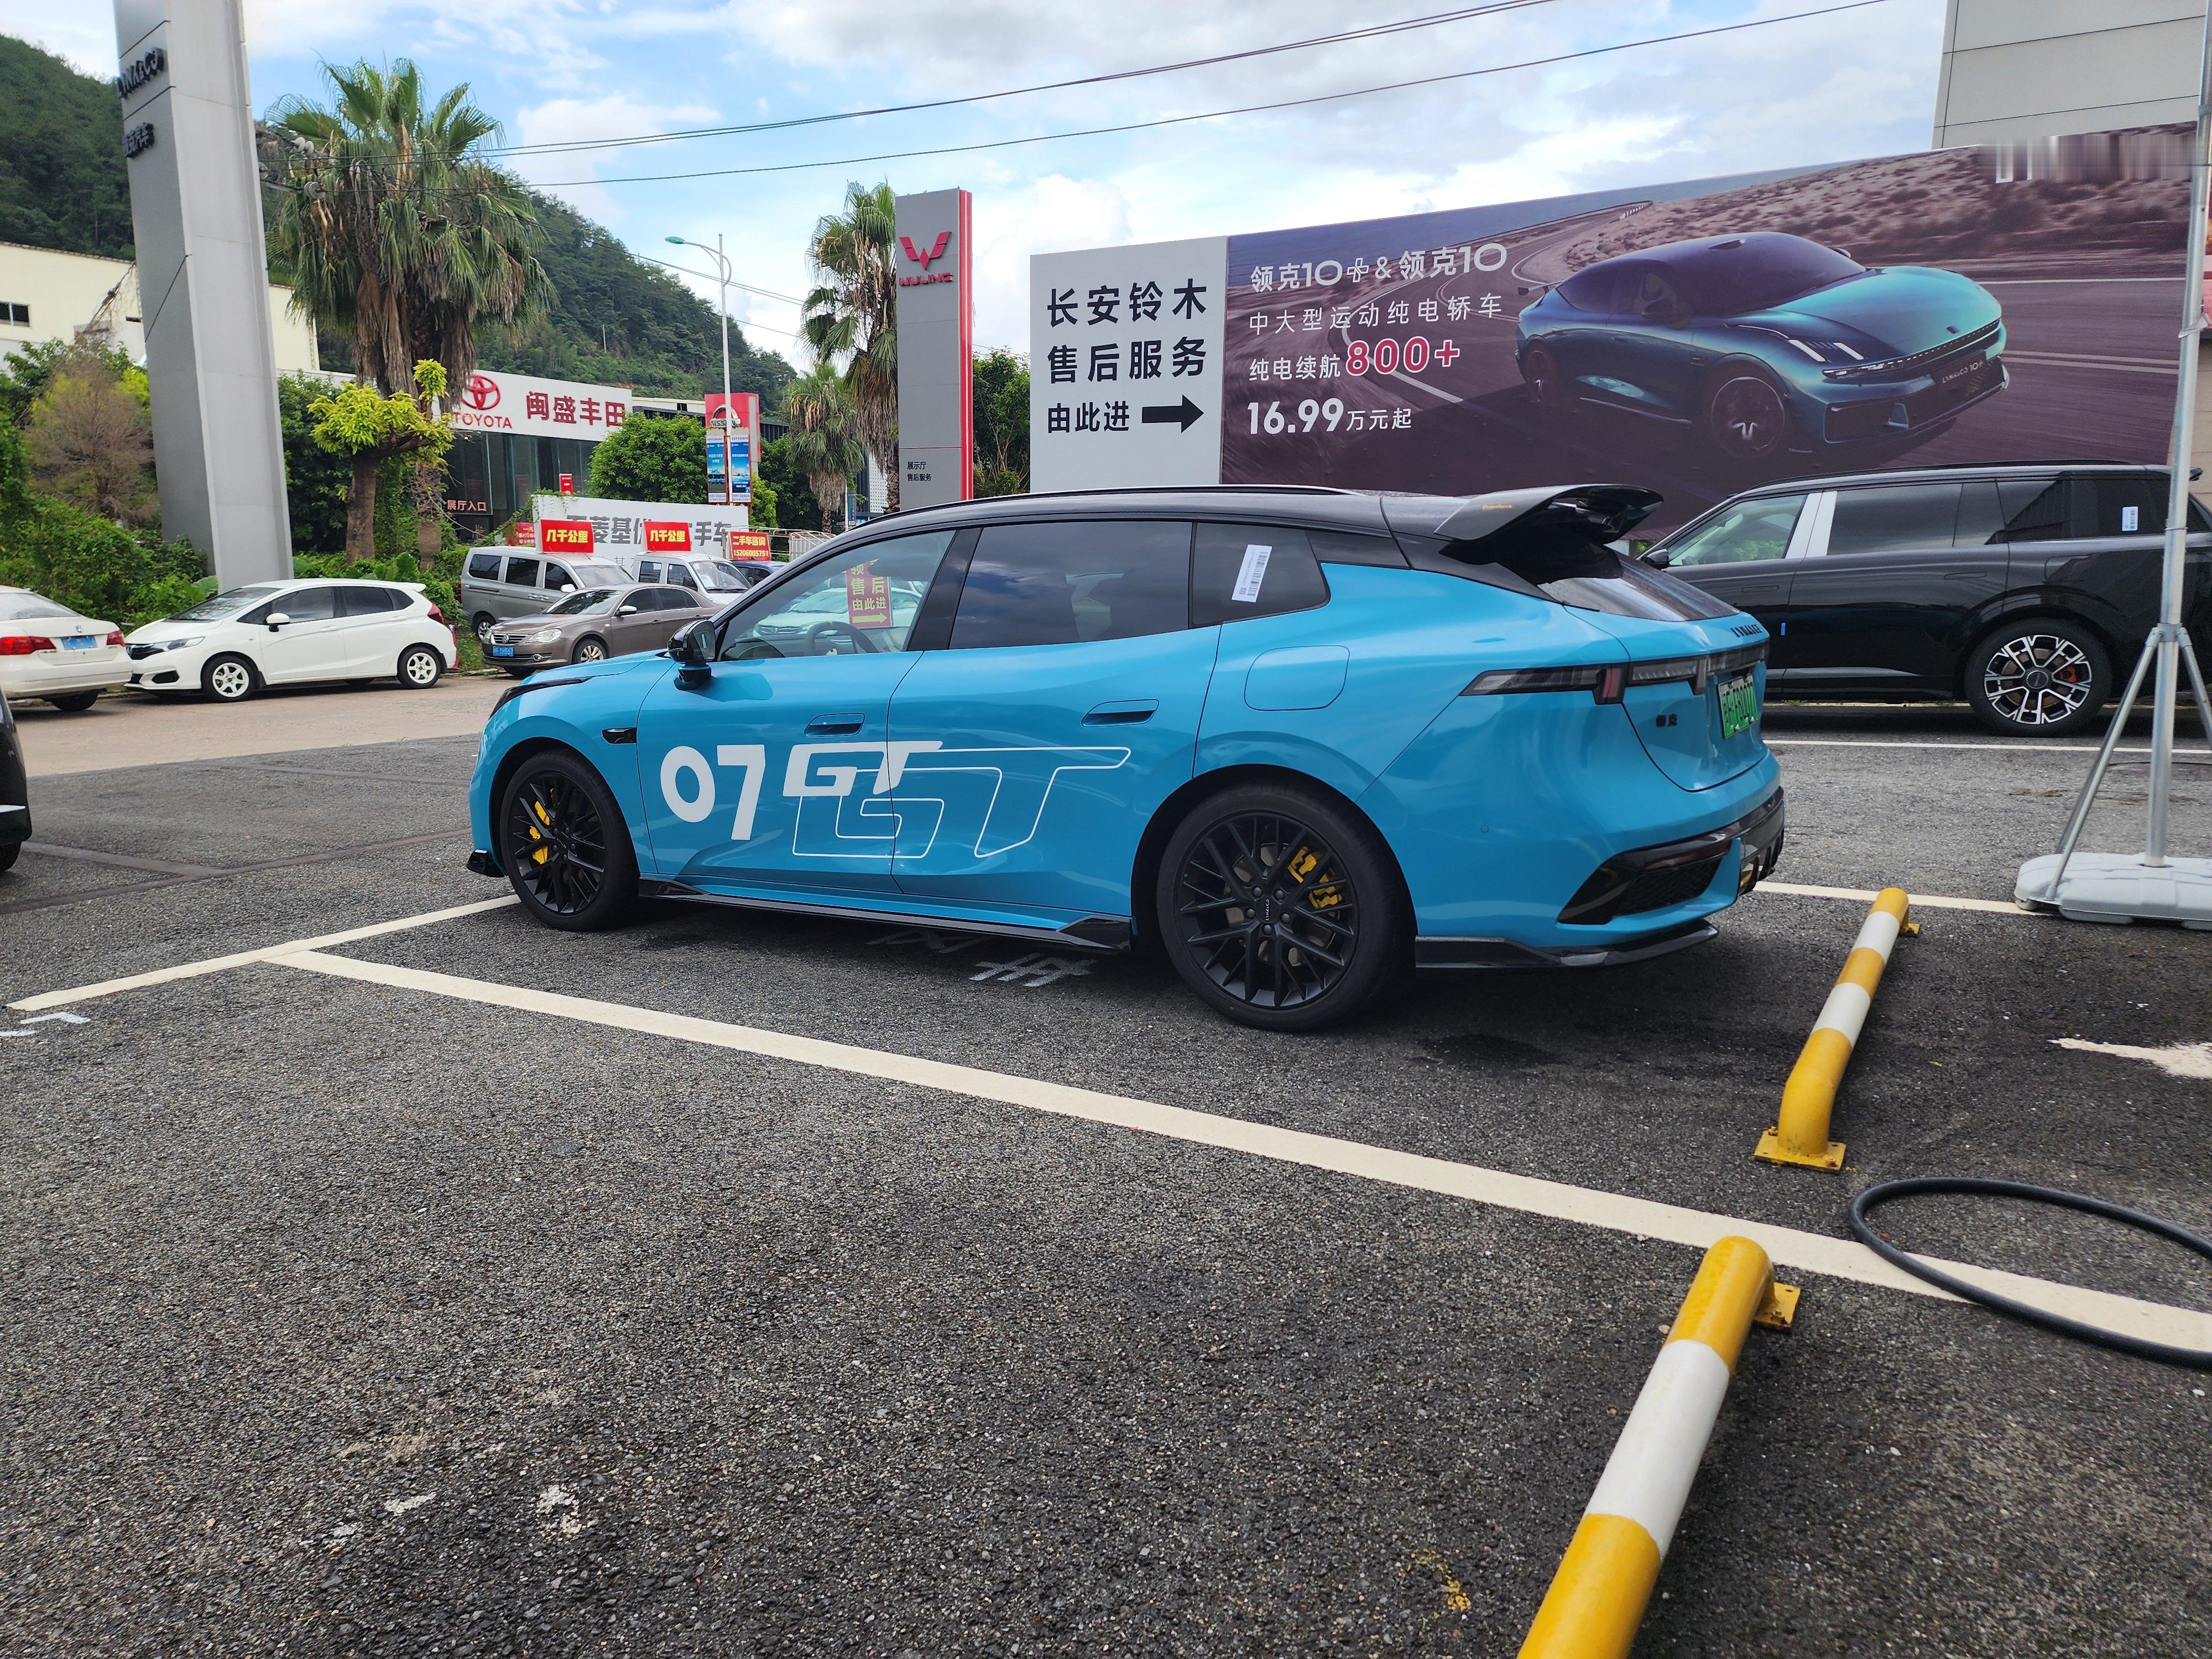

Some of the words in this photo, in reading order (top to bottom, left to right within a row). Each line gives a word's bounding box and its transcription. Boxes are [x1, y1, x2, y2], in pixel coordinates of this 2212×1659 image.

[899, 272, 952, 286] WULING
[1047, 278, 1207, 327] 长安铃木
[1249, 293, 1502, 335] 中大型运动纯电轿车
[1047, 336, 1207, 384] 售后服务
[526, 391, 625, 427] 闽盛丰田
[1048, 400, 1130, 434] 由此进
[1248, 398, 1412, 434] 16.99万元起
[453, 412, 513, 429] TOYOTA
[907, 461, 926, 469] 展示厅
[447, 499, 487, 512] 展厅入口
[546, 529, 588, 543] 几千公里
[650, 530, 686, 542] 几千公里
[733, 536, 766, 546] 二手车咨询
[851, 577, 885, 595] 售后
[852, 597, 886, 611] 由此进
[660, 744, 765, 840] 07
[782, 741, 943, 796] GT
